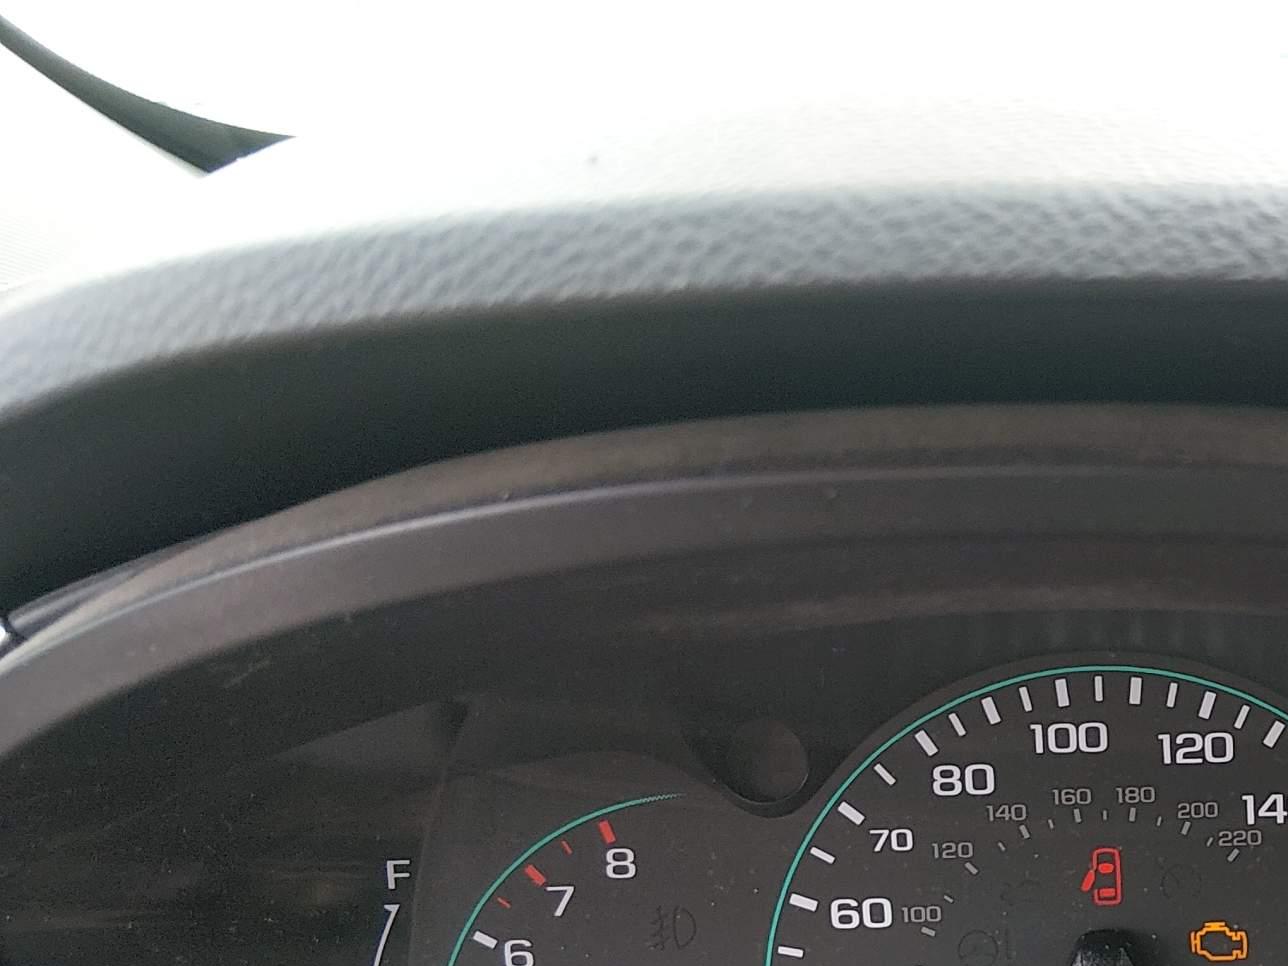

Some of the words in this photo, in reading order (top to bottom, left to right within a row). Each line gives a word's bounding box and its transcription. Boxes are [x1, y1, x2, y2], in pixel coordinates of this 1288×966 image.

[1030, 722, 1108, 755] 100
[1158, 732, 1235, 765] 120
[932, 764, 995, 796] 80
[1052, 789, 1091, 806] 160
[1116, 787, 1155, 804] 180
[986, 805, 1026, 822] 140
[1177, 803, 1218, 820] 200
[870, 829, 914, 853] 70
[932, 842, 974, 859] 120
[1218, 830, 1262, 847] 220
[387, 860, 410, 889] F
[606, 848, 635, 879] 8
[546, 886, 574, 916] 7
[830, 898, 893, 930] 60
[901, 907, 942, 924] 100
